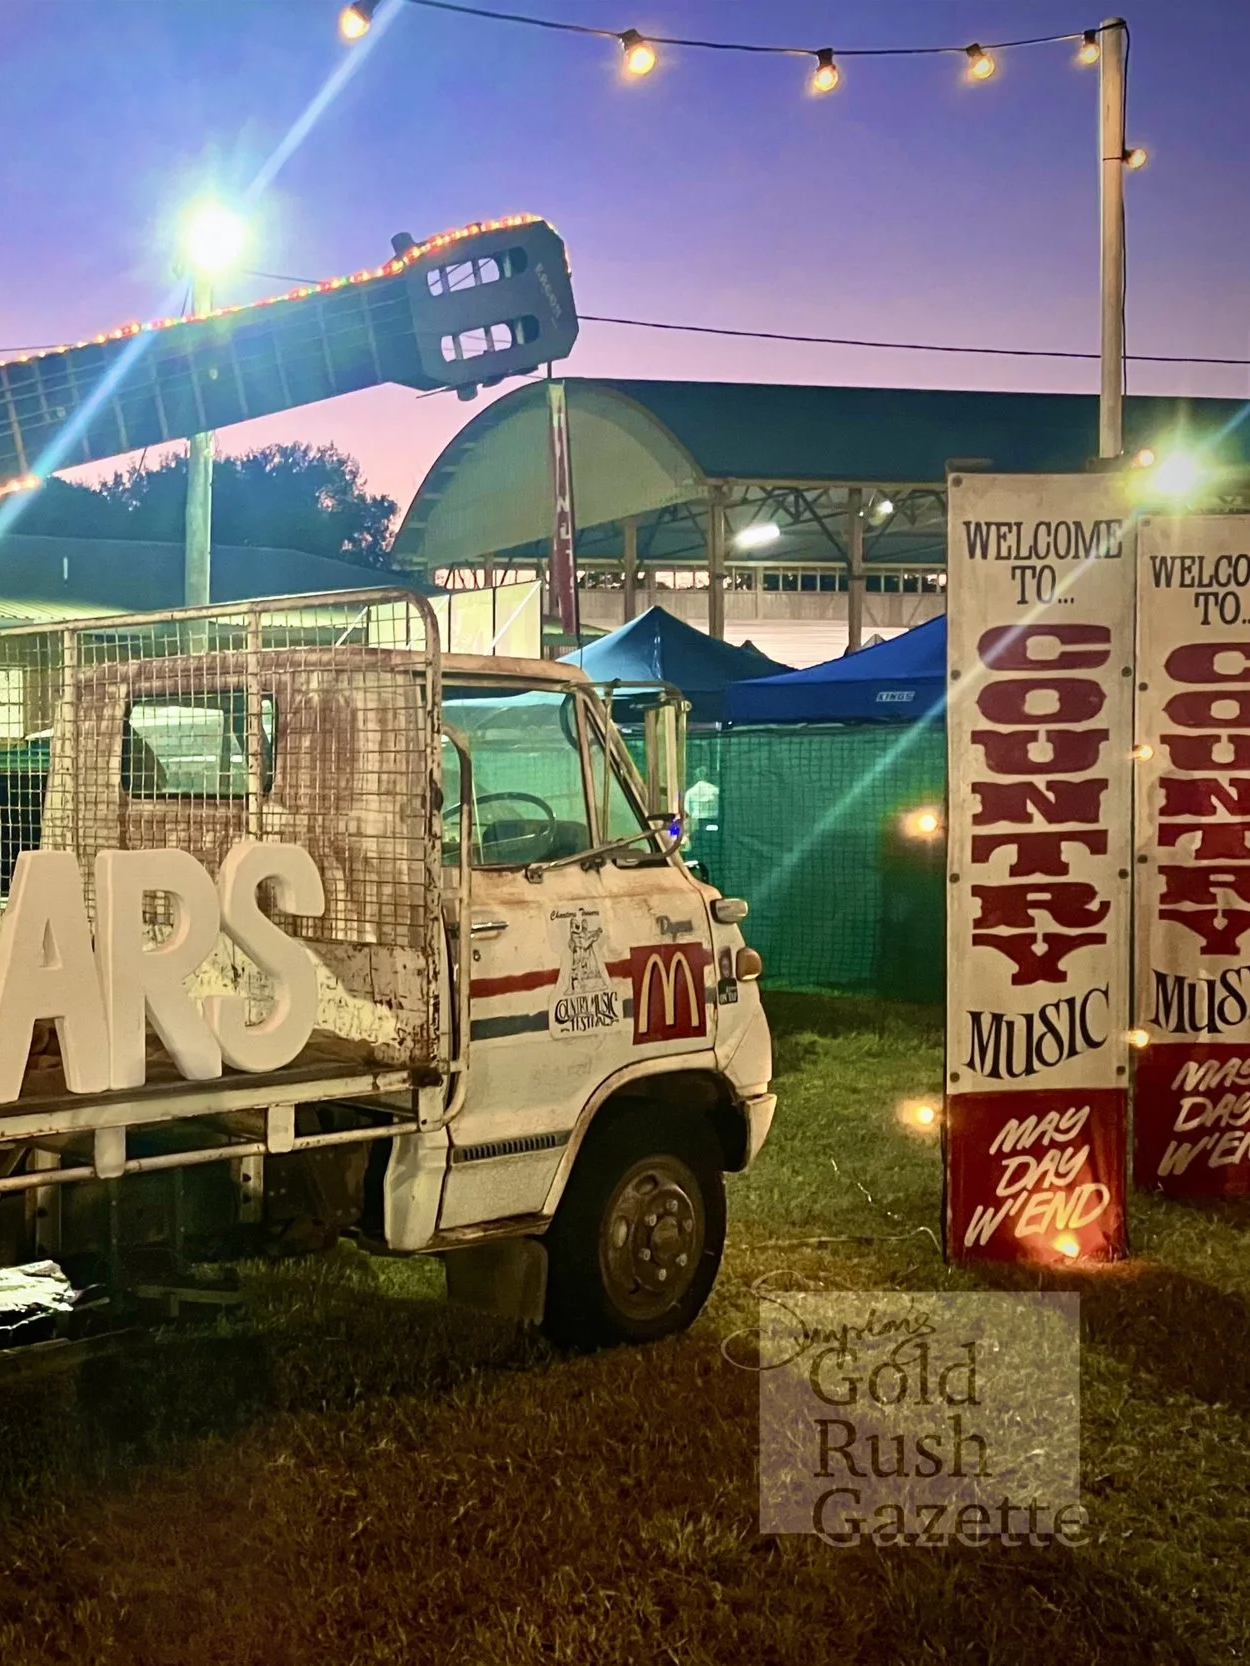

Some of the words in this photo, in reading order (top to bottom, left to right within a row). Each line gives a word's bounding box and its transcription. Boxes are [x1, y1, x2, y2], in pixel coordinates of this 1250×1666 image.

[963, 518, 1124, 561] WELCOME
[1011, 564, 1075, 606] TO...
[970, 623, 1112, 986] COUNTRY
[962, 982, 1111, 1080] MUSIC
[989, 1105, 1091, 1155] MAY
[995, 1144, 1091, 1197] DAY
[963, 1182, 1111, 1248] W'END
